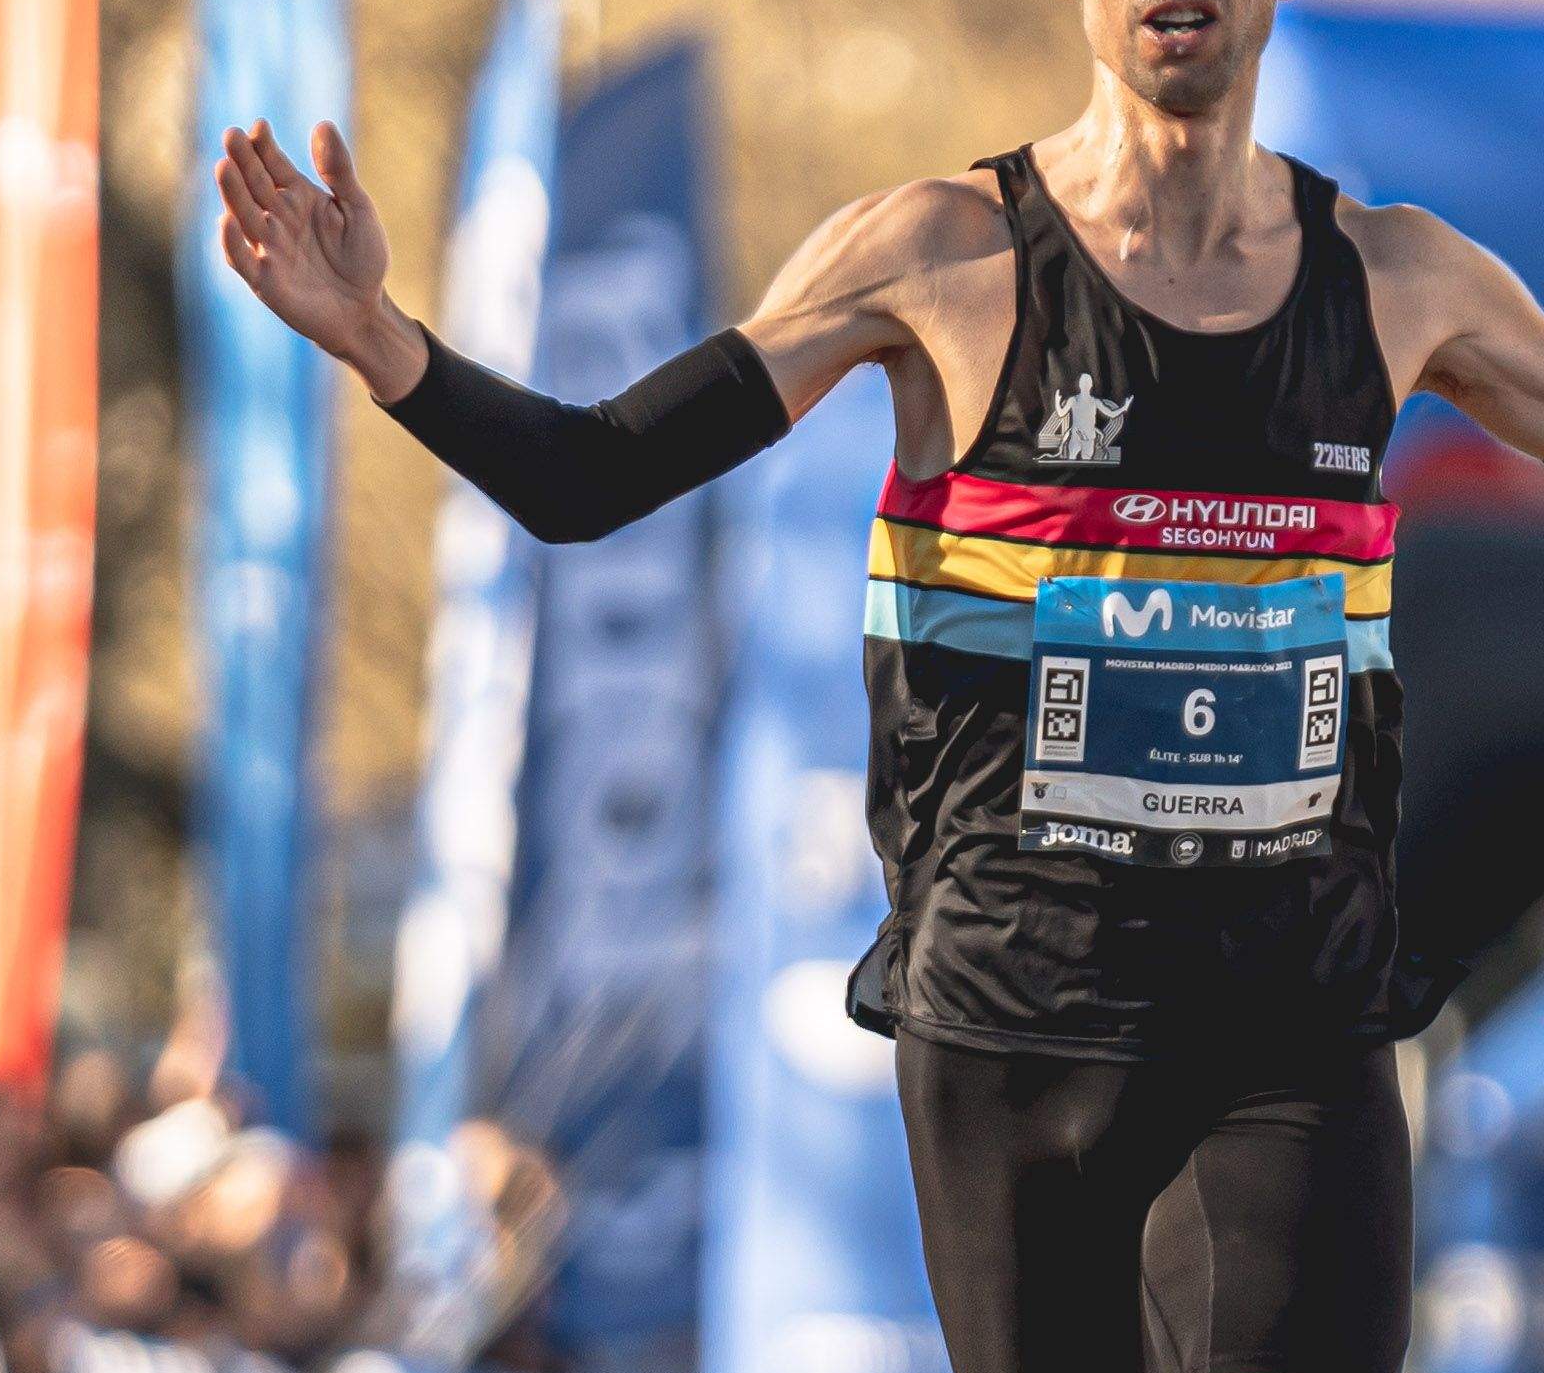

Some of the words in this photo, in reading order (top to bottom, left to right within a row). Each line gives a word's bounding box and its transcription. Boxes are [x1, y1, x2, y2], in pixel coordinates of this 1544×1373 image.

[1313, 442, 1371, 473] 226ERS
[1170, 498, 1316, 529] HYUNDAI
[1161, 527, 1276, 550] SEGOHYUN
[1190, 603, 1297, 630] Movistar
[1105, 659, 1154, 670] MOVISTAR
[1156, 660, 1195, 671] MADRID
[1196, 661, 1228, 672] MEDIO
[1183, 687, 1217, 737] 6
[1149, 747, 1181, 763] ÉLITE
[1188, 752, 1212, 764] SUB
[1142, 792, 1245, 816] GUERRA
[1256, 830, 1319, 858] MADRID
